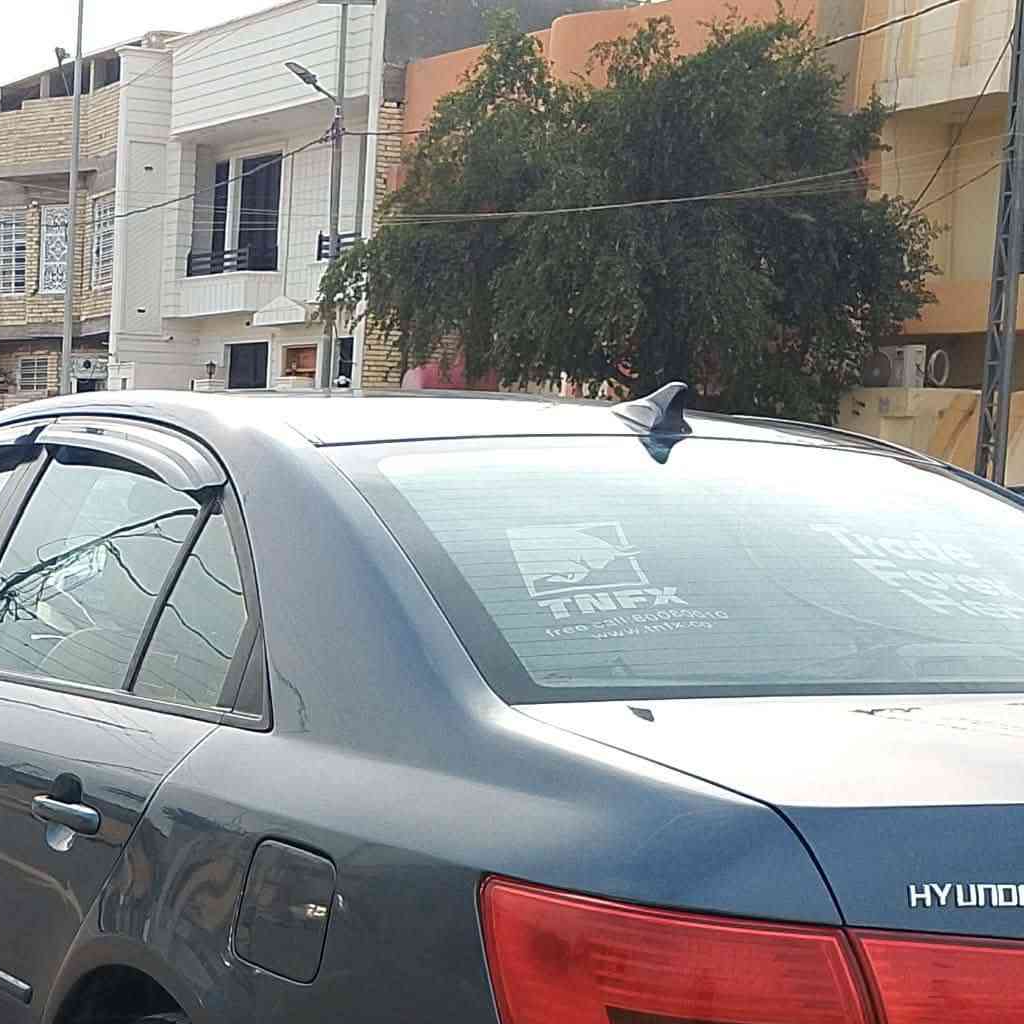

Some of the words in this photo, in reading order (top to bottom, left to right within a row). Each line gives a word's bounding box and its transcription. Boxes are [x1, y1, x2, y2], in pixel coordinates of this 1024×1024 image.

[808, 523, 981, 568] Trade
[537, 586, 689, 620] TNFX
[545, 624, 589, 638] free
